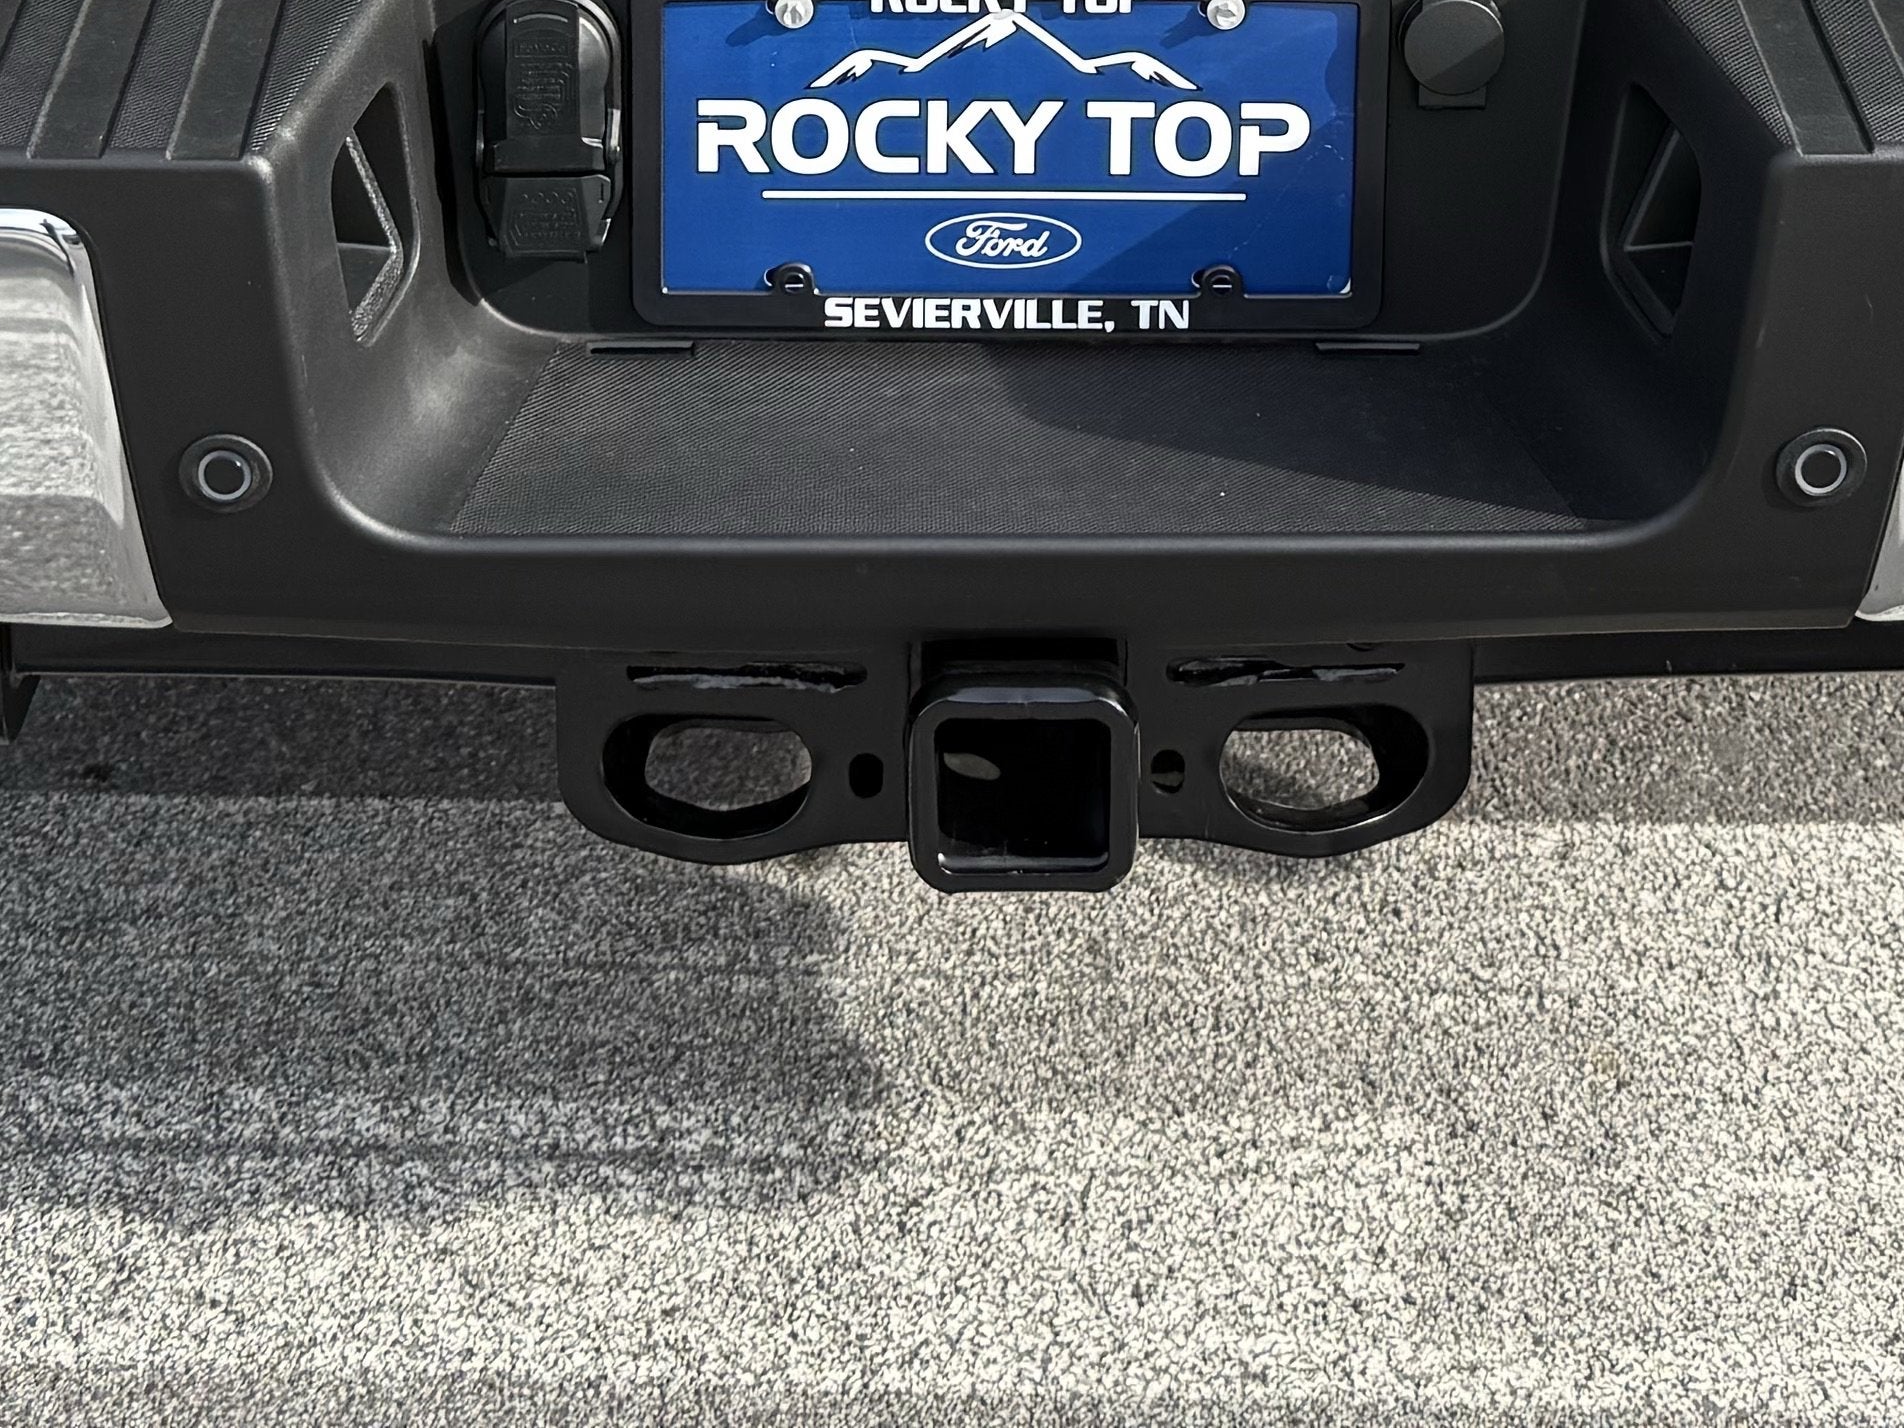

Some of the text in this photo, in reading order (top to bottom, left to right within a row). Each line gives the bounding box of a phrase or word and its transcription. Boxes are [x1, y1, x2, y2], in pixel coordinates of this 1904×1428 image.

[698, 98, 1311, 178] ROCKY TOP
[955, 219, 1051, 259] Ford
[824, 296, 1190, 332] SEVIERVILLE, TN
